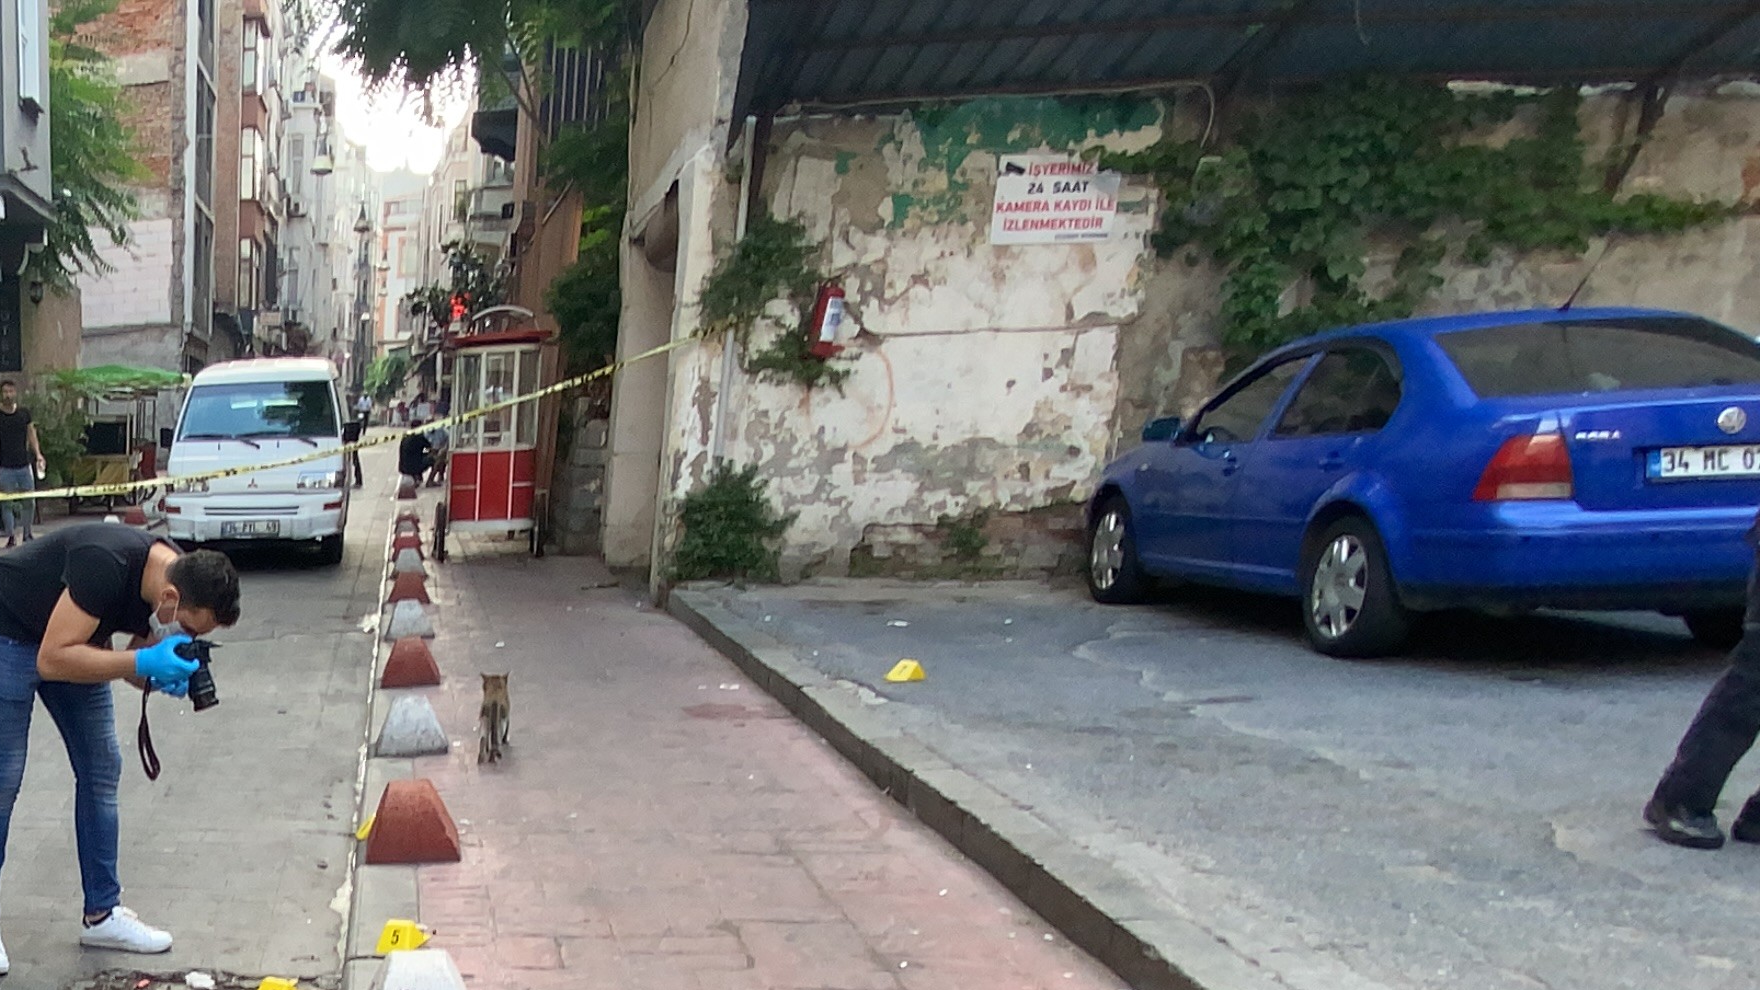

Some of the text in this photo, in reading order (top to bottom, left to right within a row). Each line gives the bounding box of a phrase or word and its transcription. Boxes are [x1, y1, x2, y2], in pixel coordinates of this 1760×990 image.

[1028, 180, 1090, 194] 24 SAAT
[996, 194, 1115, 213] KAMERA KAYDI İLE
[1003, 215, 1104, 232] İZLENMEKTEDİR
[1663, 447, 1760, 473] 34 MC 0
[390, 929, 400, 946] 5
